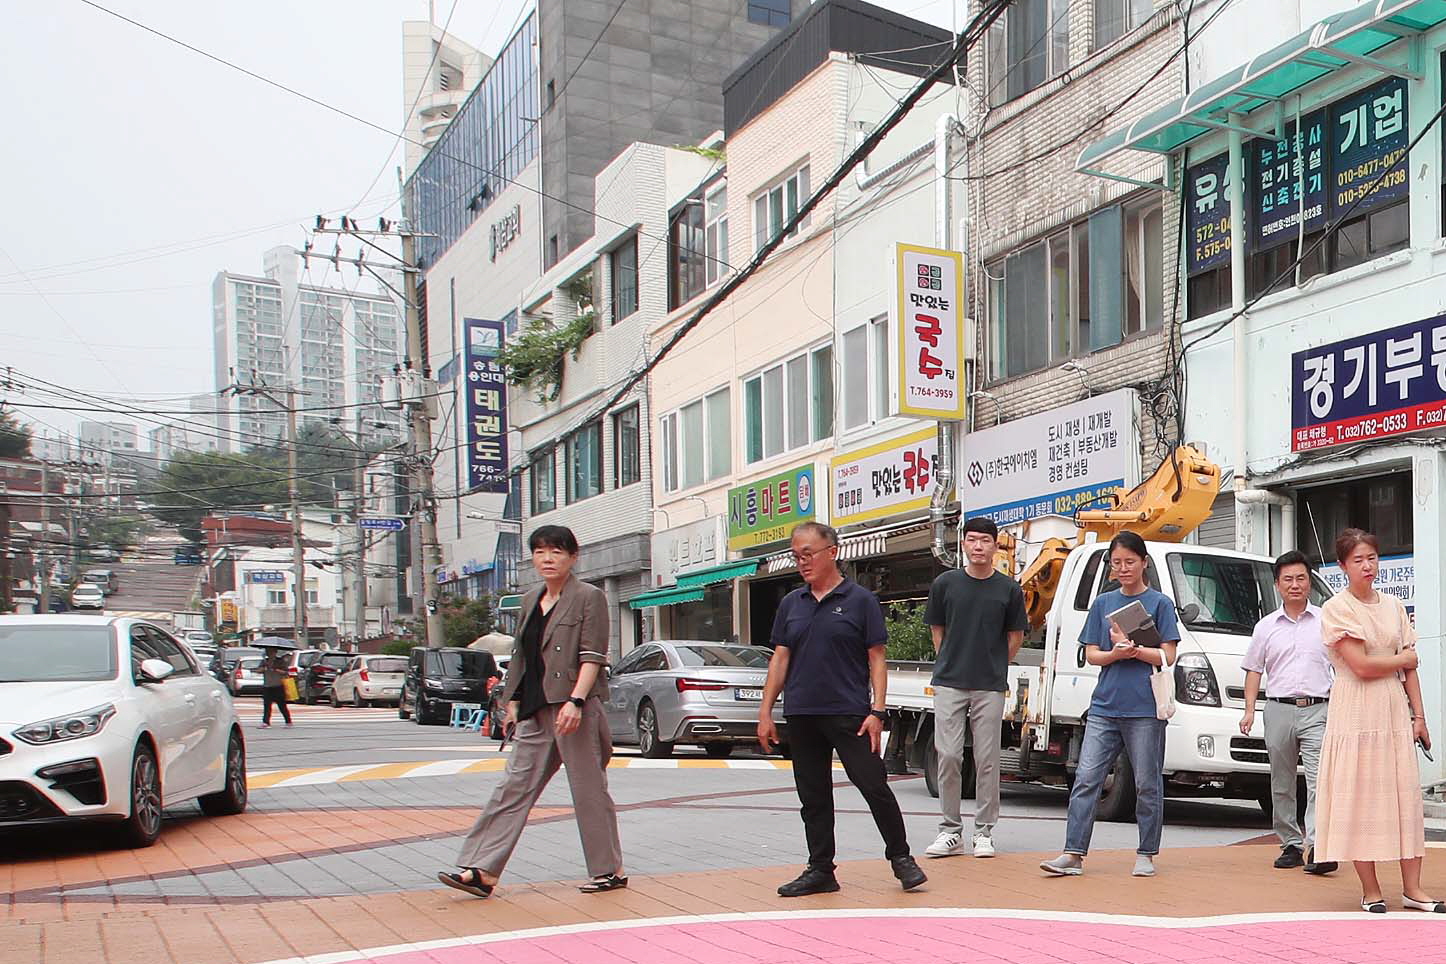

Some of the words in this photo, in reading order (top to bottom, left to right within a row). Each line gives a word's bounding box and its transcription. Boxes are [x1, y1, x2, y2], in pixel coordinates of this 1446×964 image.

[1339, 89, 1403, 154] 기업
[910, 292, 950, 311] 맛있는
[910, 385, 953, 399] T.764-3959
[474, 388, 502, 461] 태권도
[1048, 423, 1063, 443] 도시
[871, 463, 901, 498] 맛있는
[731, 480, 792, 529] 시흥마트
